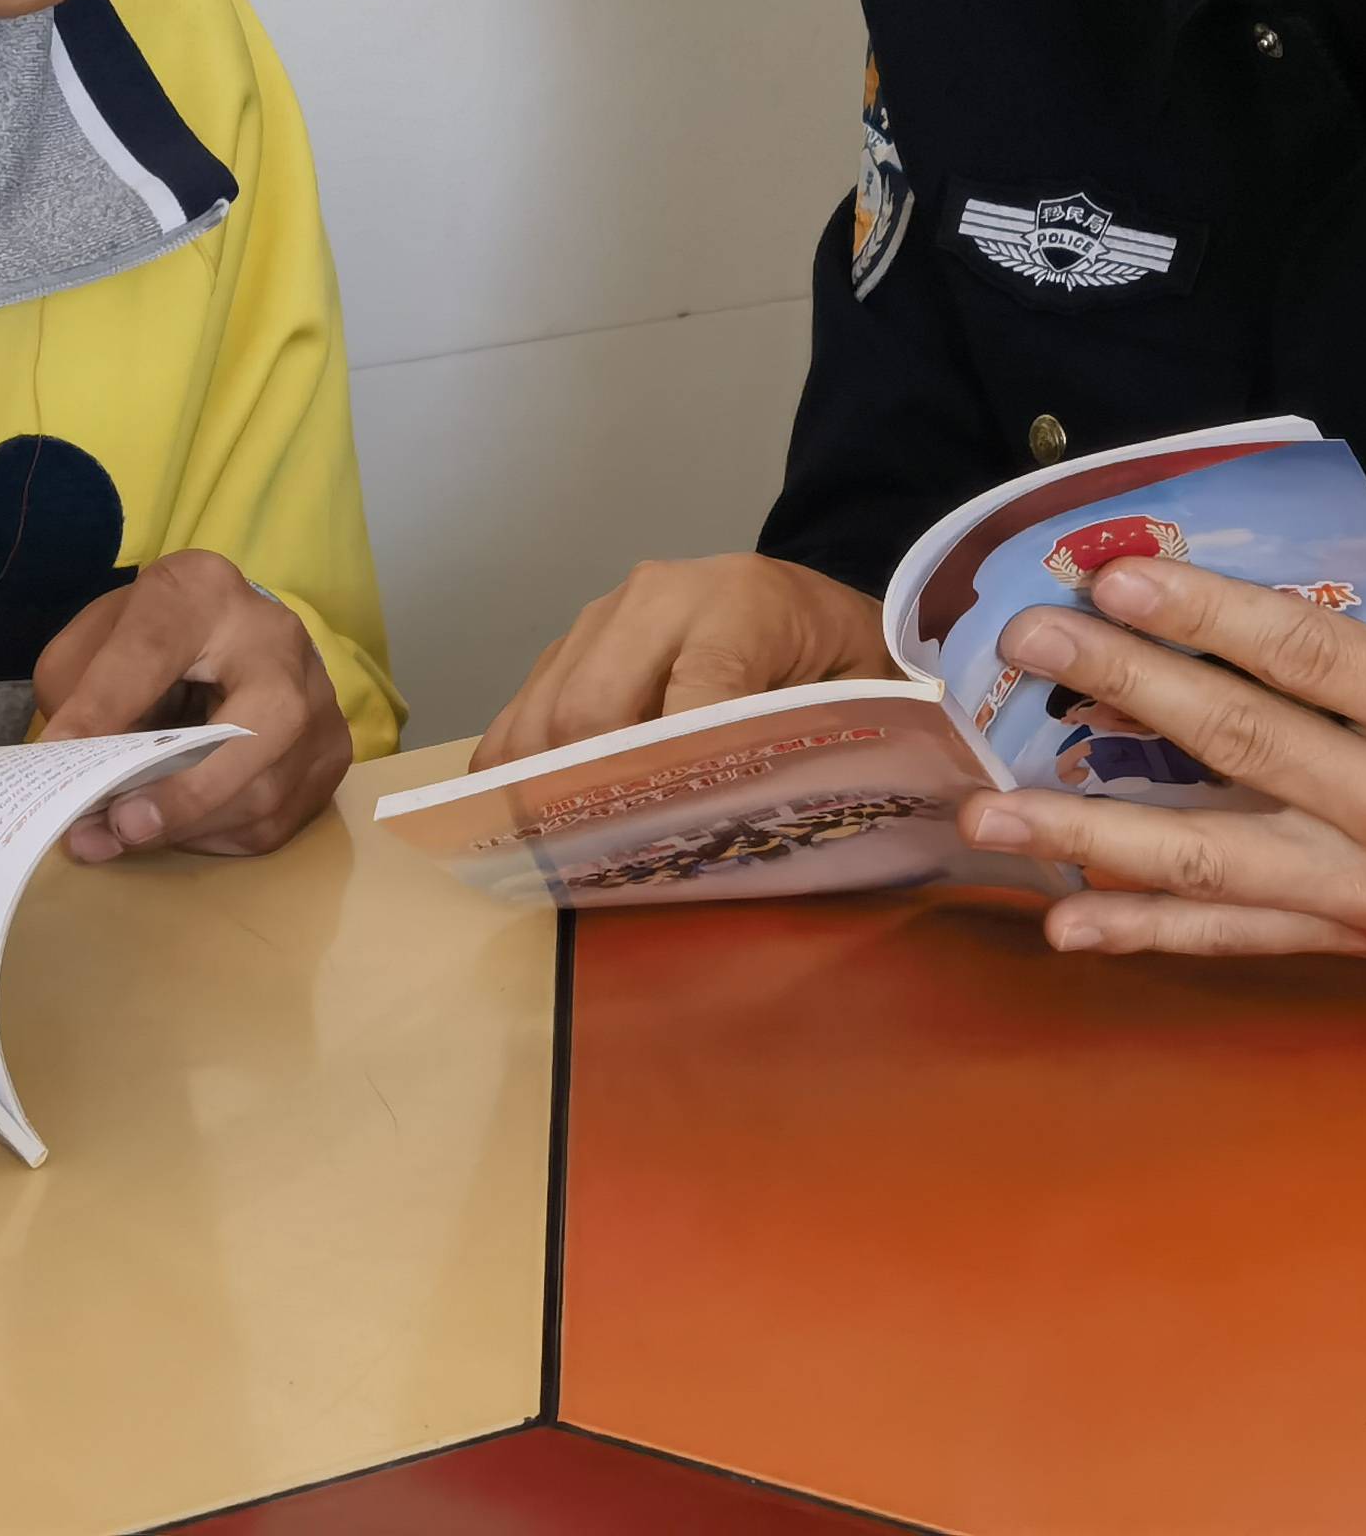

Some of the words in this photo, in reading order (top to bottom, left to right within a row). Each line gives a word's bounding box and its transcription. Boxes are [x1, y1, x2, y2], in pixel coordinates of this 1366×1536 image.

[1040, 205, 1105, 234] 移民局
[1037, 232, 1093, 254] POLICE
